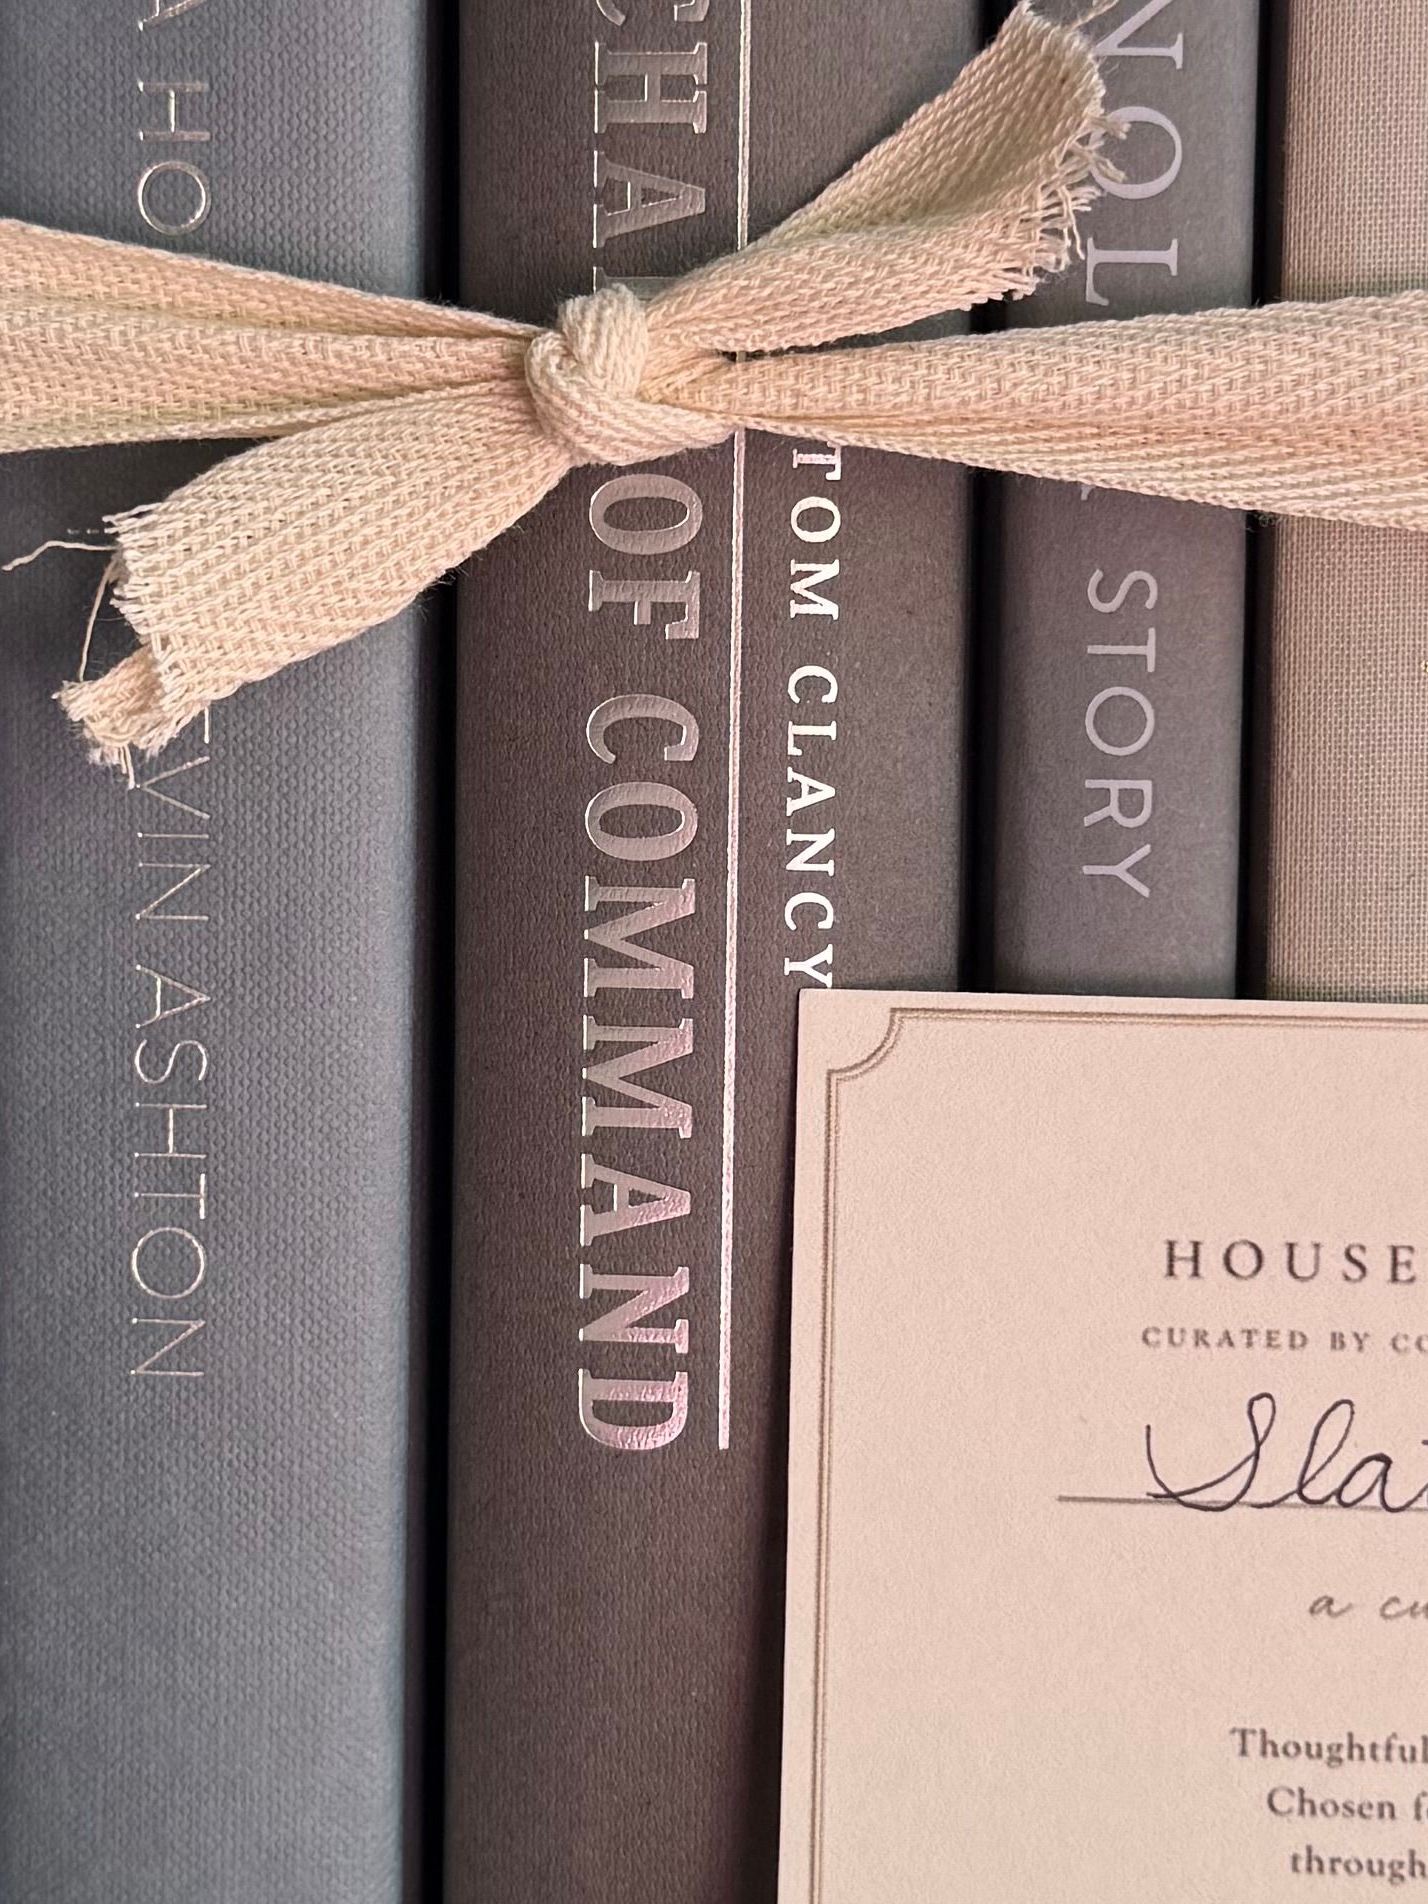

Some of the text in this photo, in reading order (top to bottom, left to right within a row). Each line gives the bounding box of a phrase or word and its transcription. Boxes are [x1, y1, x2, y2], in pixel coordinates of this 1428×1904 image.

[587, 470, 706, 643] OF
[783, 443, 843, 989] TOM CLANCY
[1080, 569, 1158, 899] STORY
[129, 706, 212, 1379] VIN ASHTON
[577, 693, 701, 1452] COMMAND
[1163, 1238, 1418, 1286] HOUSE
[1141, 1325, 1309, 1352] CURATED
[1329, 1330, 1371, 1354] BY
[1307, 1594, 1354, 1619] a
[1266, 1785, 1397, 1822] Chosen
[1290, 1844, 1428, 1886] through
